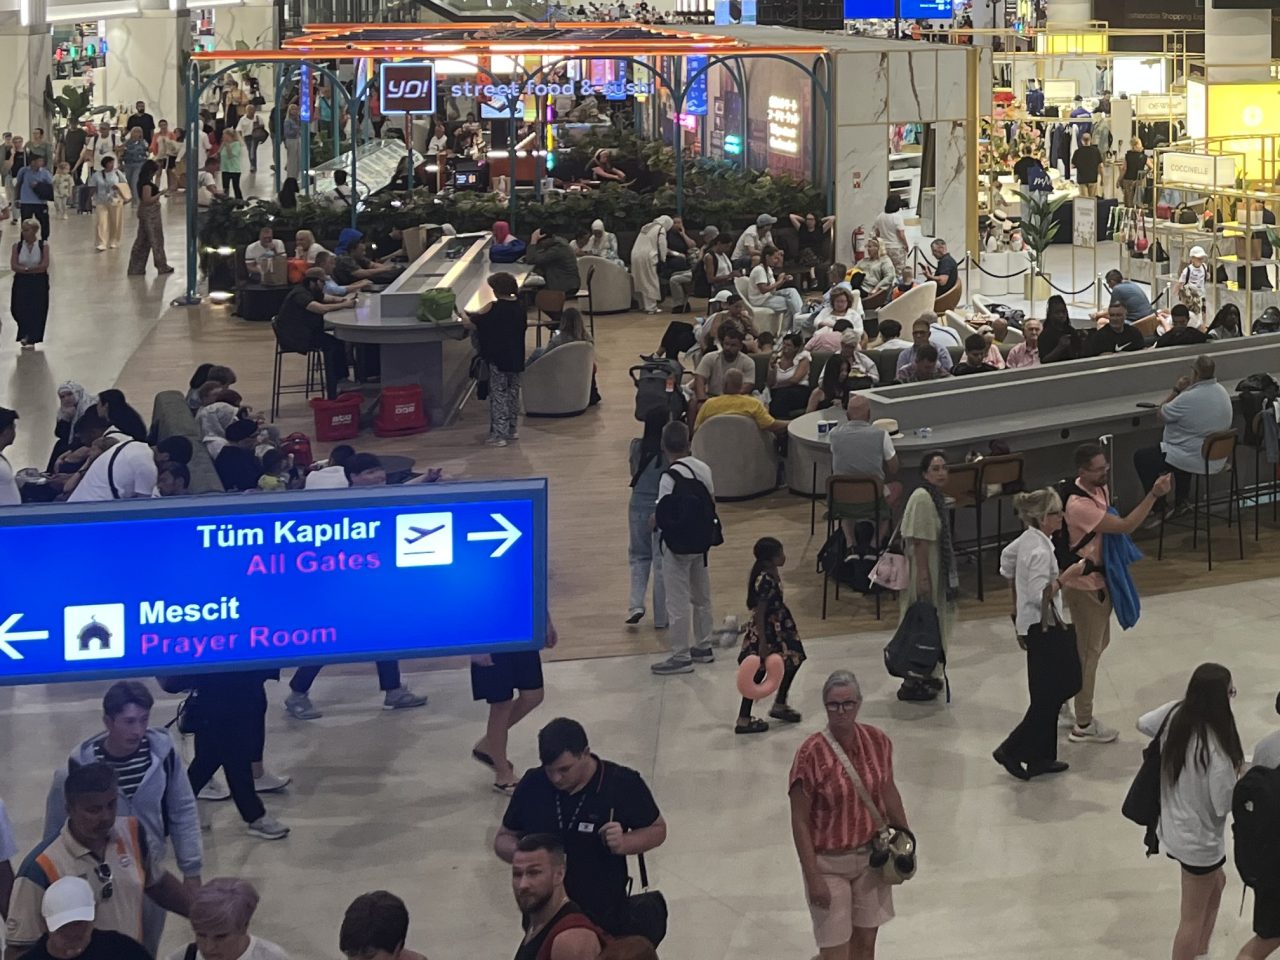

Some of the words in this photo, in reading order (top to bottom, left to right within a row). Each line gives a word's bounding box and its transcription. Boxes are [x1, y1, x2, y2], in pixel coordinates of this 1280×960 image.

[387, 80, 429, 98] YO!
[451, 81, 520, 97] street
[526, 79, 575, 96] food
[581, 79, 596, 96] &
[602, 78, 655, 96] sushi
[1170, 163, 1209, 175] COCCINELLE
[197, 524, 264, 548] Tüm
[274, 517, 381, 547] Kapılar
[246, 553, 286, 576] All
[296, 550, 382, 574] Gates
[139, 596, 240, 625] Mescit
[140, 632, 239, 658] Prayer
[250, 625, 337, 649] Room
